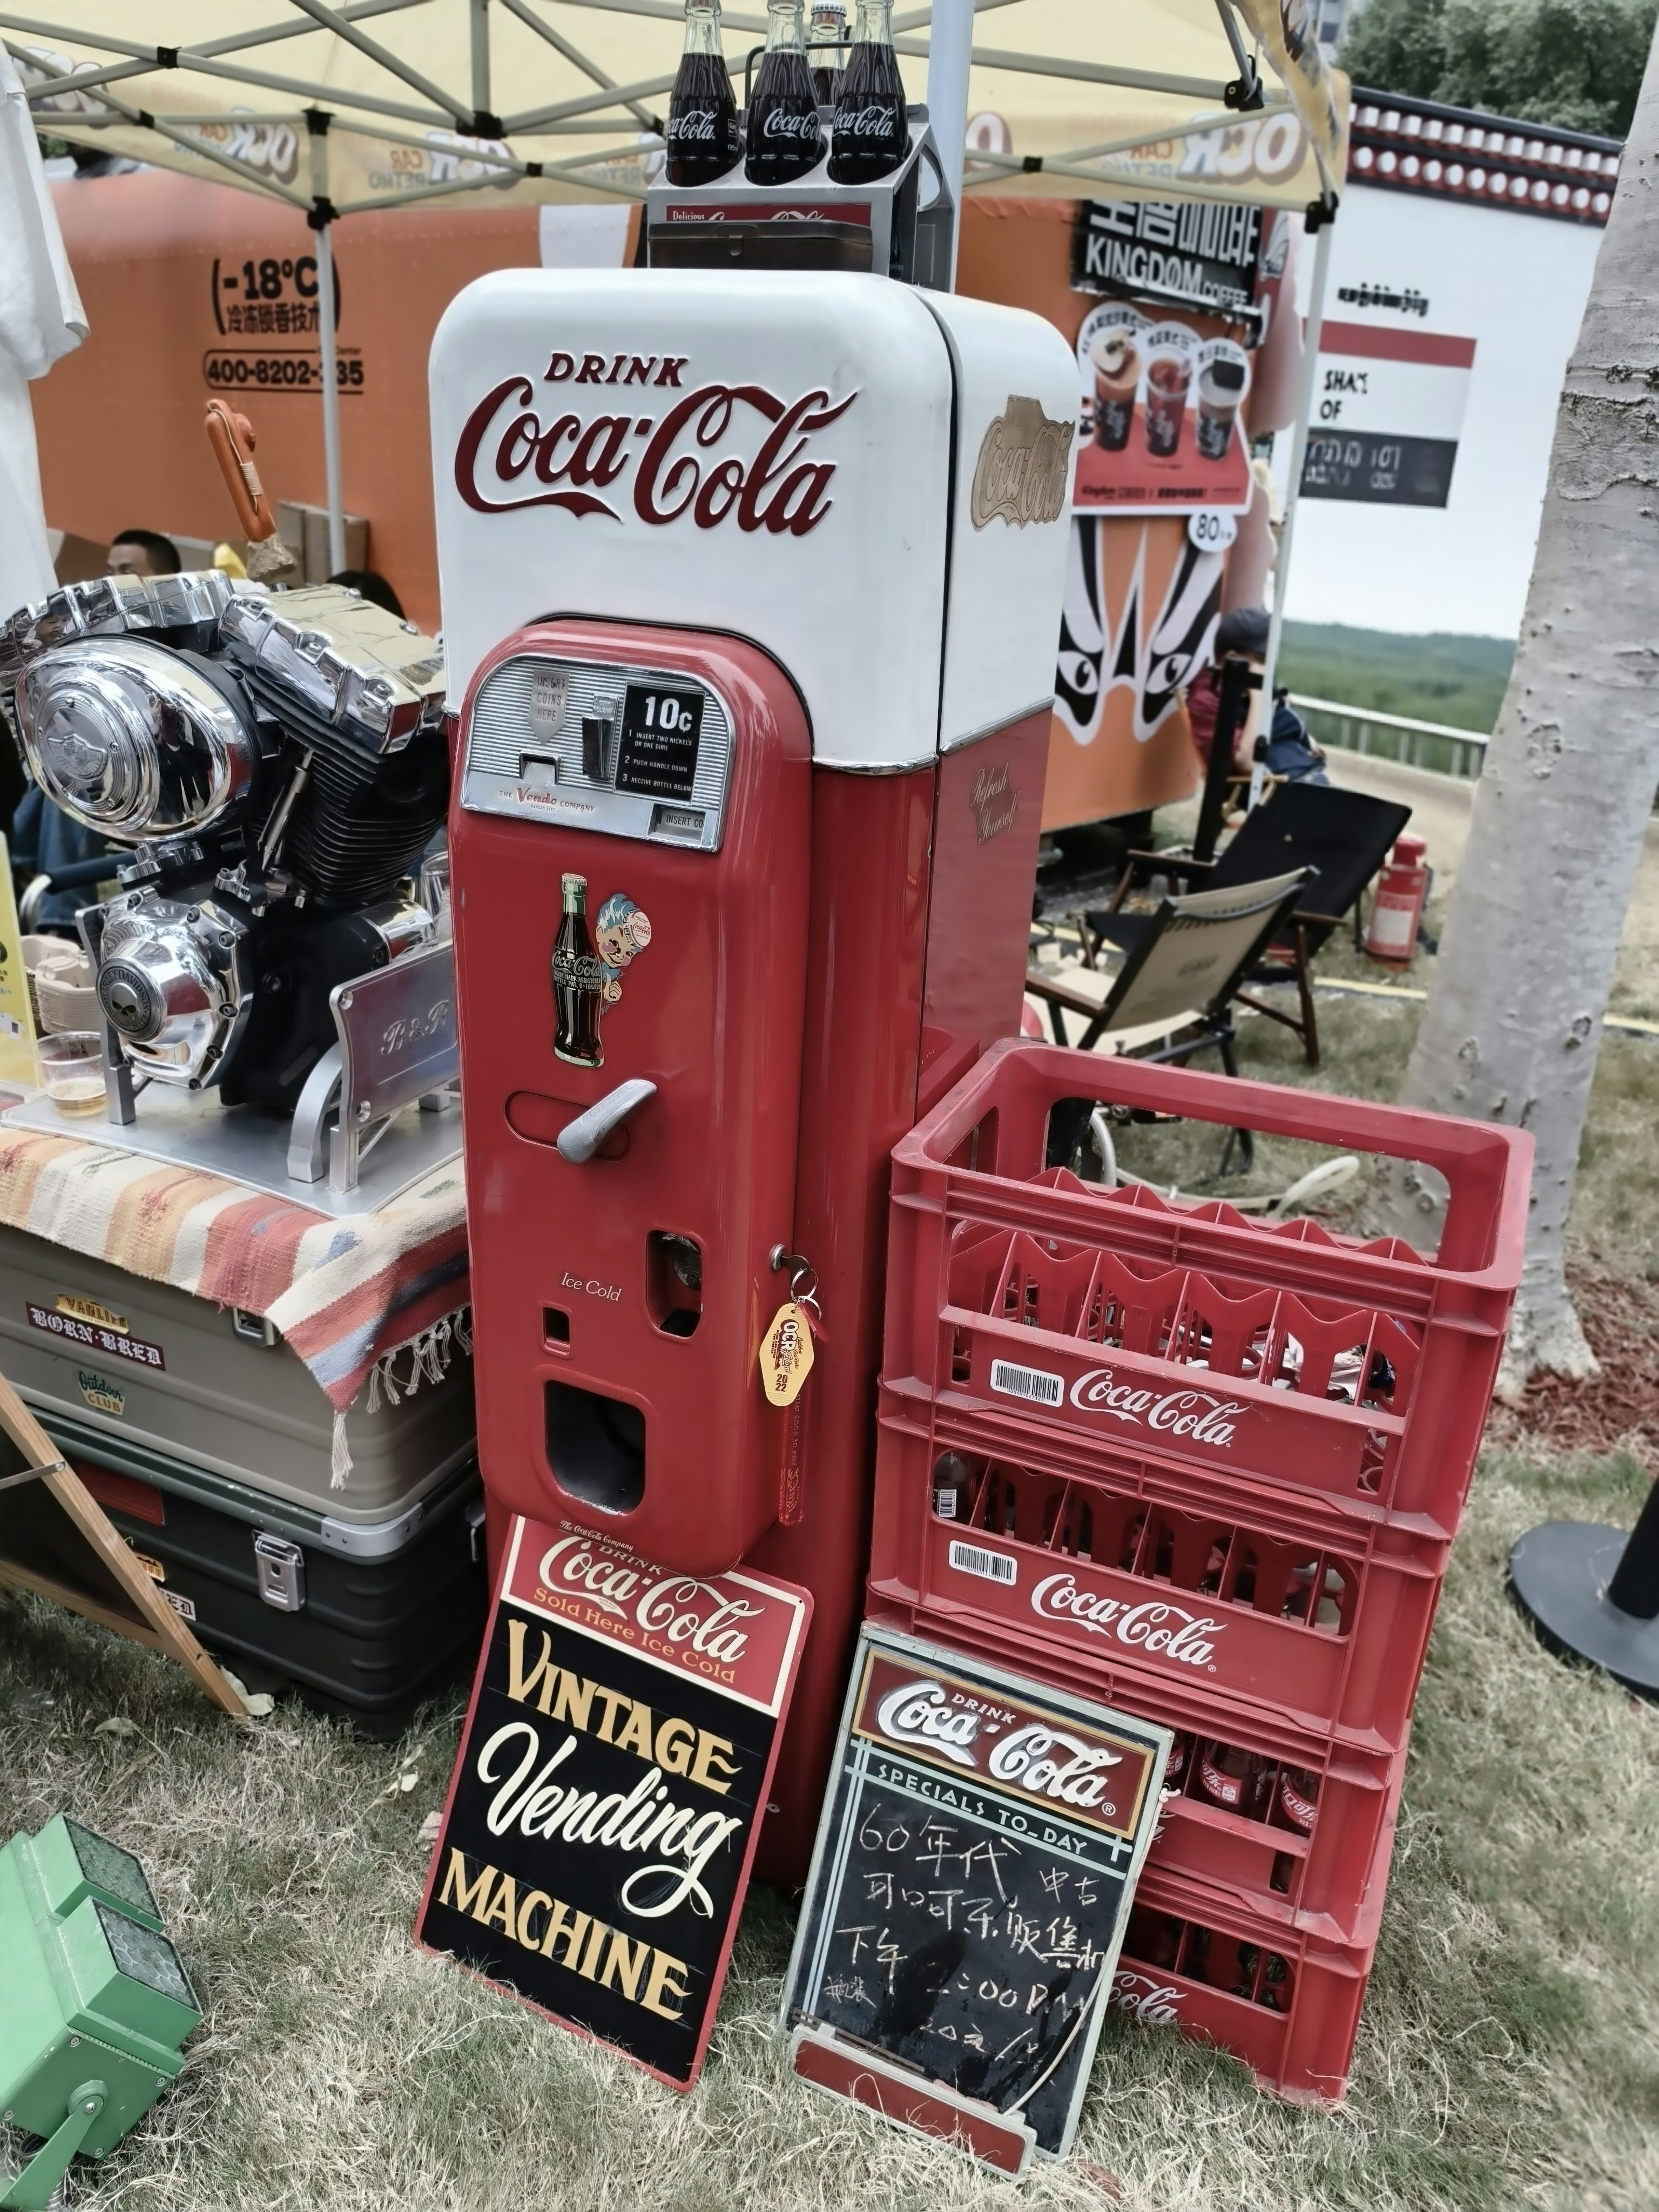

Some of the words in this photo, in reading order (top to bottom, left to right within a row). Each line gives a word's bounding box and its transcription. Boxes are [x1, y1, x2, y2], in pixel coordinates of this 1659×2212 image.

[673, 211, 704, 221] Delicious
[1085, 234, 1203, 296] KINGDOM
[543, 352, 689, 387] DRINK
[455, 376, 859, 537] Coca-Cola
[537, 676, 565, 690] INSERT
[537, 692, 562, 706] COINS
[537, 709, 557, 721] HERE
[636, 732, 655, 740] INSERT
[670, 737, 692, 746] NICKELS
[655, 743, 669, 751] DIME
[625, 756, 630, 764] 2
[649, 761, 670, 770] HANDLE
[671, 764, 687, 773] DOWN
[622, 773, 628, 782] 3
[631, 777, 652, 786] RECEIVE
[653, 780, 672, 789] BOTTLE
[673, 784, 692, 792] BELOW
[516, 787, 558, 805] Vendo
[559, 801, 595, 812] COMPANY
[666, 814, 691, 827] INSERT
[552, 950, 601, 977] Coca-Cola
[561, 1272, 582, 1290] Ice
[585, 1280, 622, 1301] Cold
[780, 1319, 799, 1351] OCR
[78, 1370, 124, 1402] Outdoor
[775, 1382, 787, 1392] 22
[776, 1373, 788, 1384] 20
[88, 1393, 120, 1413] CLUB
[1070, 1368, 1255, 1448] Coca-Cola
[559, 1520, 572, 1531] The
[574, 1526, 603, 1541] Coca-Cola
[603, 1535, 634, 1553] Company
[539, 1535, 767, 1663] Coca-Cola
[534, 1587, 581, 1617] Sold
[584, 1608, 636, 1640] Here
[641, 1631, 675, 1656] Ice
[682, 1650, 736, 1683] Cold
[1031, 1573, 1229, 1667] Coca-Cola
[508, 1619, 743, 1795] VINTAGE
[951, 1692, 1017, 1725] DRINK
[878, 1681, 1123, 1808] Coca-Cola
[879, 1763, 985, 1817] SPECIALS
[477, 1722, 743, 1919] Vending
[439, 1846, 693, 2021] MACHINE
